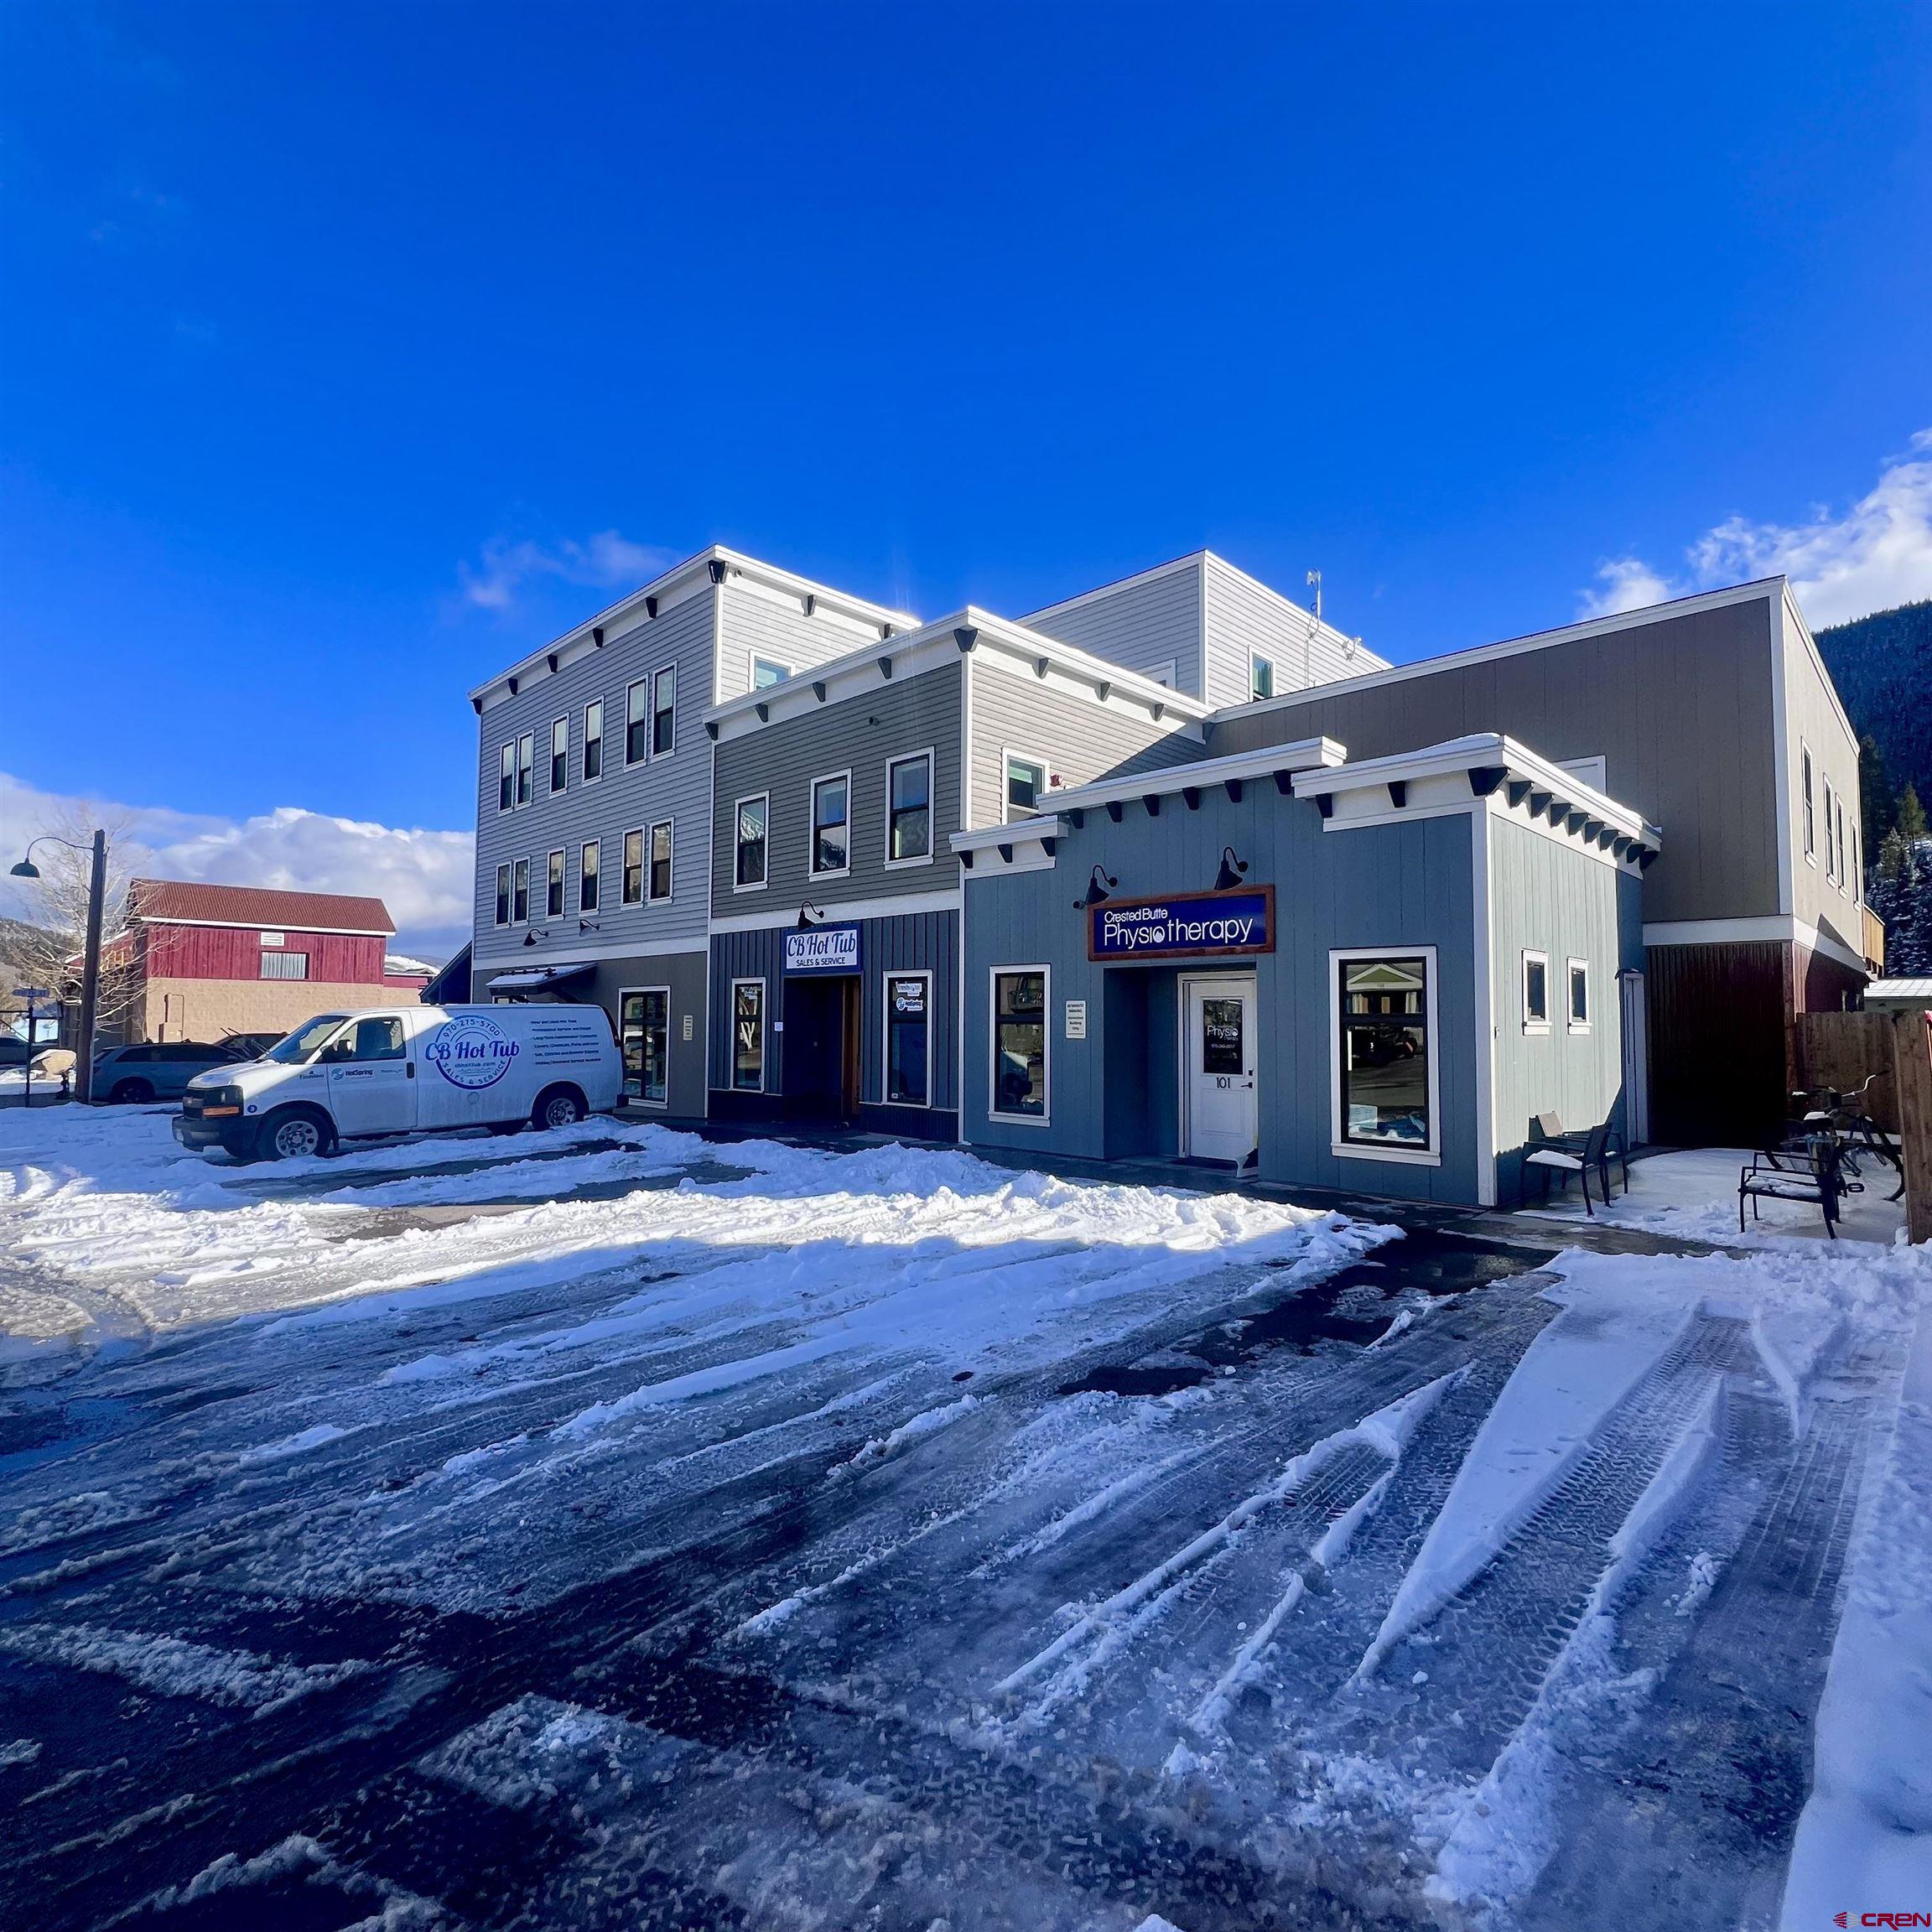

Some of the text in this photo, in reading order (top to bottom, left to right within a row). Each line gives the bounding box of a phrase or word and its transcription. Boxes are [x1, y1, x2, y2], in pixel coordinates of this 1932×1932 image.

[1104, 908, 1168, 922] Crested Butte
[788, 932, 856, 957] CB Hot Tub
[822, 957, 845, 965] SERVICE
[443, 1019, 501, 1037] 970-275-5700
[425, 1041, 520, 1061] CB Hot Tub
[442, 1062, 465, 1083] SALES
[478, 1059, 506, 1084] SERVICE
[1217, 1078, 1230, 1088] 101
